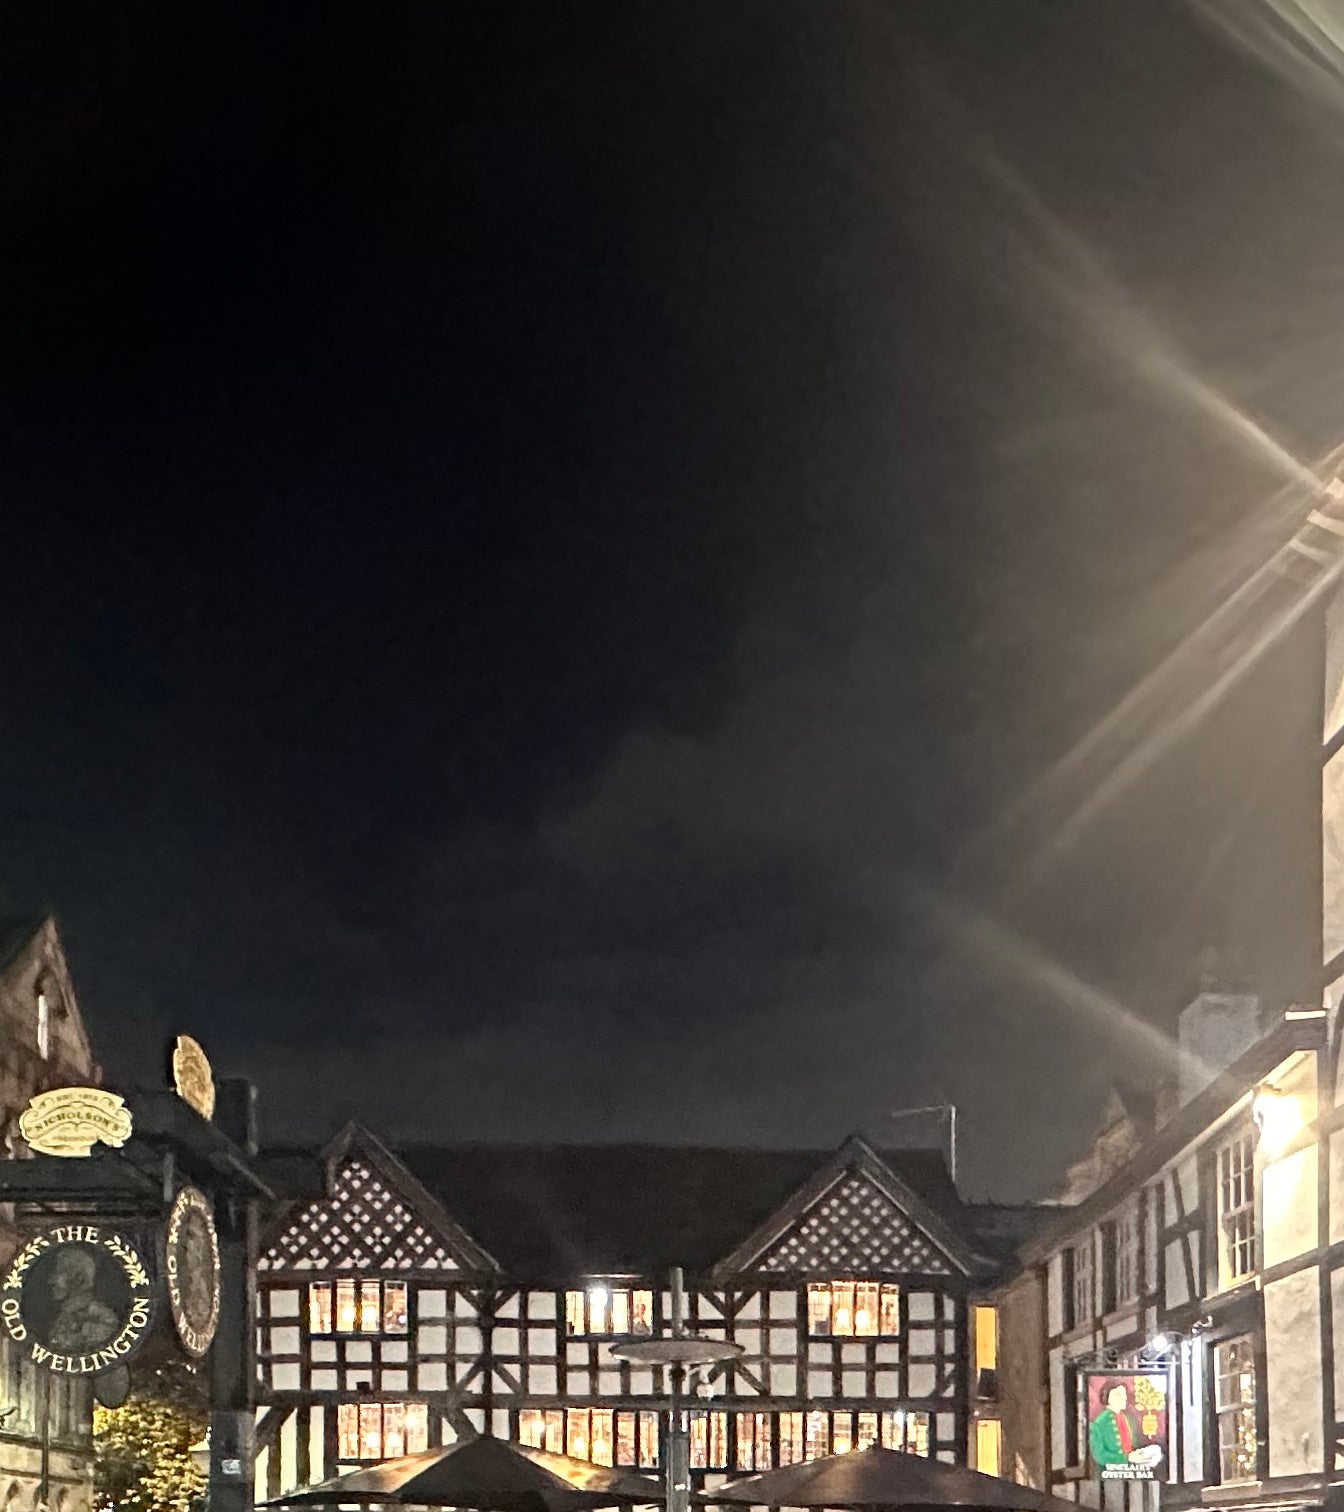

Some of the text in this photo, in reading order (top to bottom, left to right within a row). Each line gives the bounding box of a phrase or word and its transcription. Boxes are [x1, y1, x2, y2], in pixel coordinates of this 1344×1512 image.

[51, 1225, 100, 1244] THE
[1, 1298, 27, 1341] OLD
[30, 1297, 150, 1373] WELLINGTON
